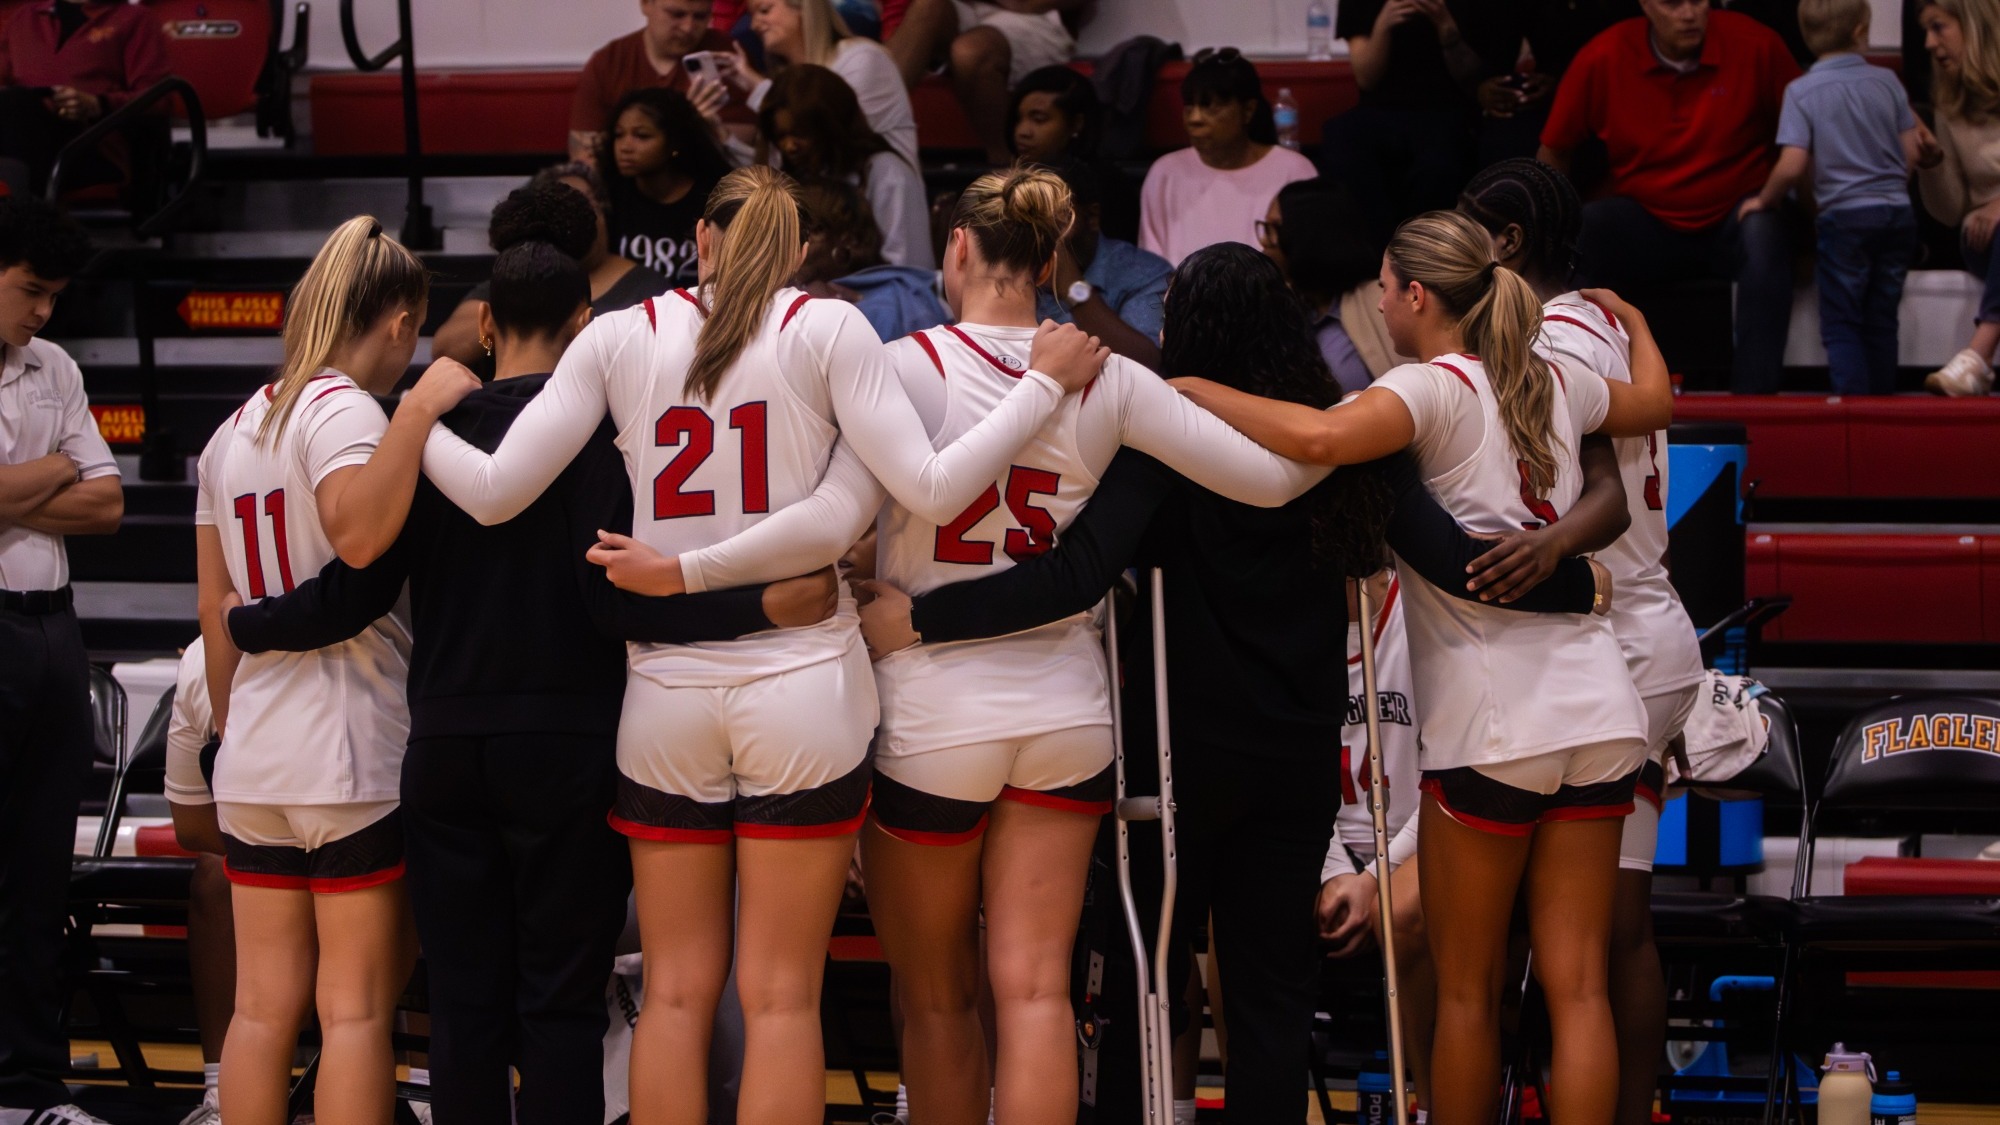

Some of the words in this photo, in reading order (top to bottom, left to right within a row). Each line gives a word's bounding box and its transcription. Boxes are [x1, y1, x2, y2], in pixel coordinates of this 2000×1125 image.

[619, 233, 699, 280] 1982
[188, 296, 226, 309] THIS
[232, 296, 279, 309] AISLE
[191, 309, 278, 323] RESERVED
[653, 400, 769, 520] 21
[233, 487, 296, 600] 11
[933, 464, 1061, 565] 25
